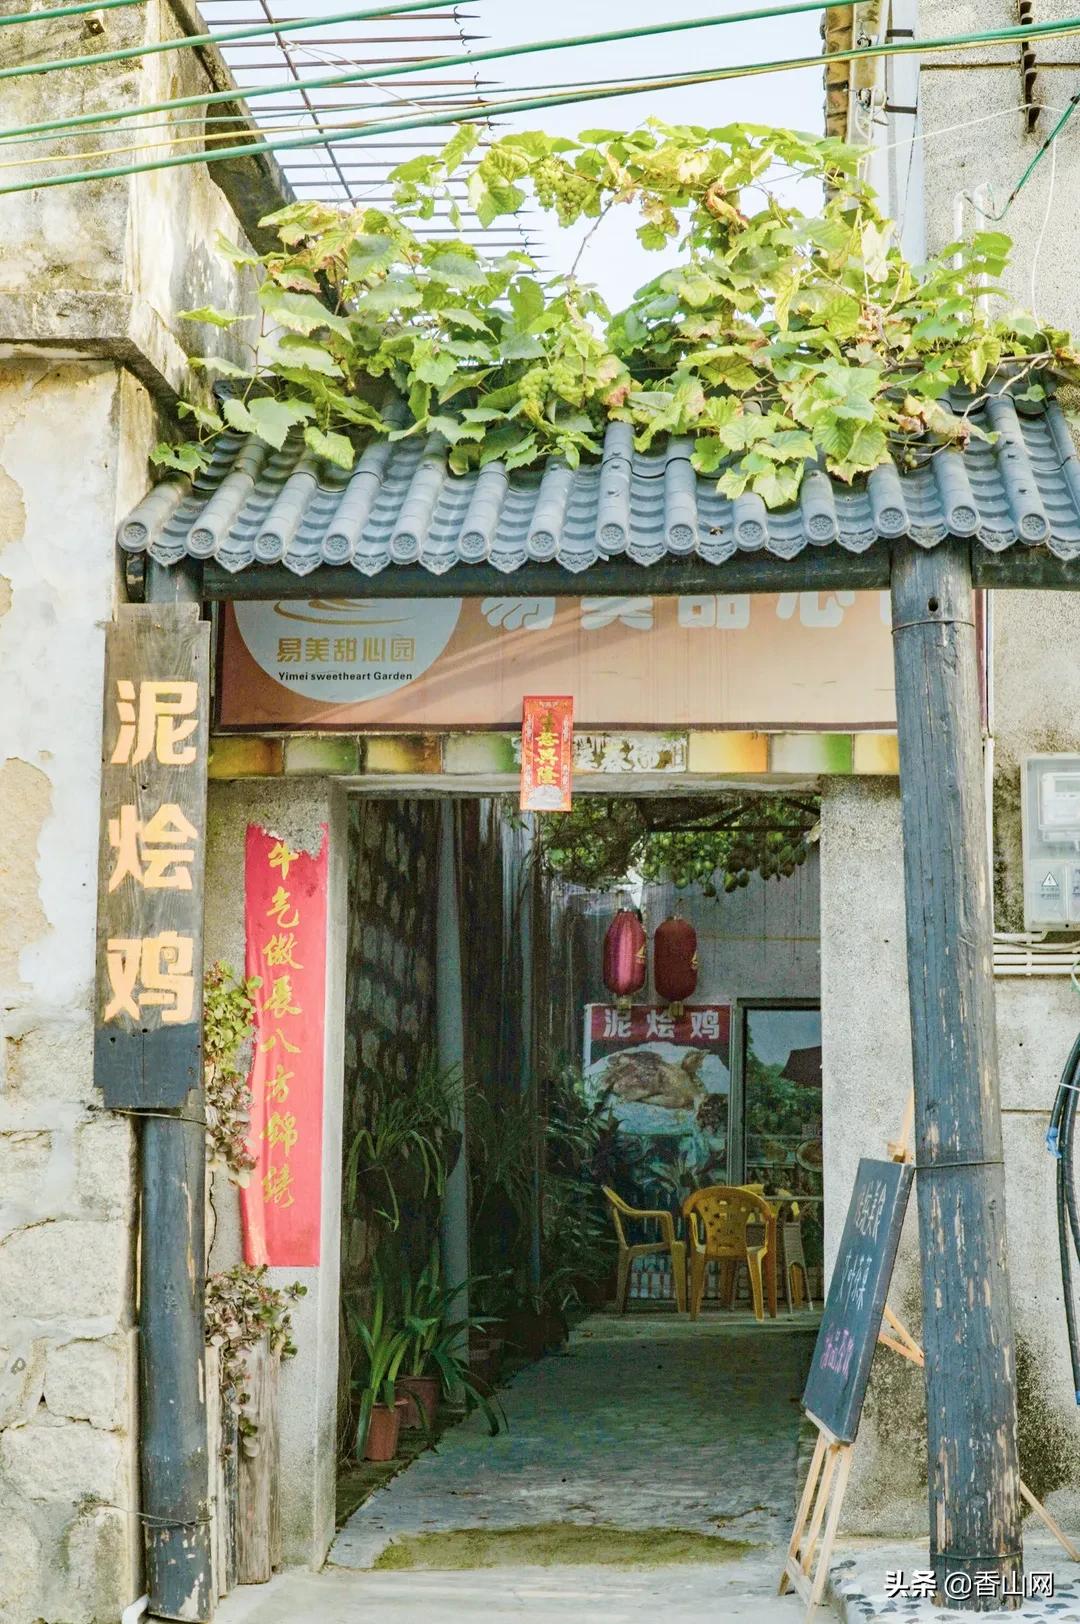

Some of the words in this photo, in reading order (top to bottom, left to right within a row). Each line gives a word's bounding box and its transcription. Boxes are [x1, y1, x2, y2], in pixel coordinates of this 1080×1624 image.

[277, 637, 416, 663] 易美甜心园
[278, 671, 309, 681] Yimei
[310, 671, 371, 681] sweetheart
[373, 671, 413, 681] Garden
[103, 679, 198, 1023] 泥烩鸡
[603, 1008, 720, 1040] 泥烩鸡
